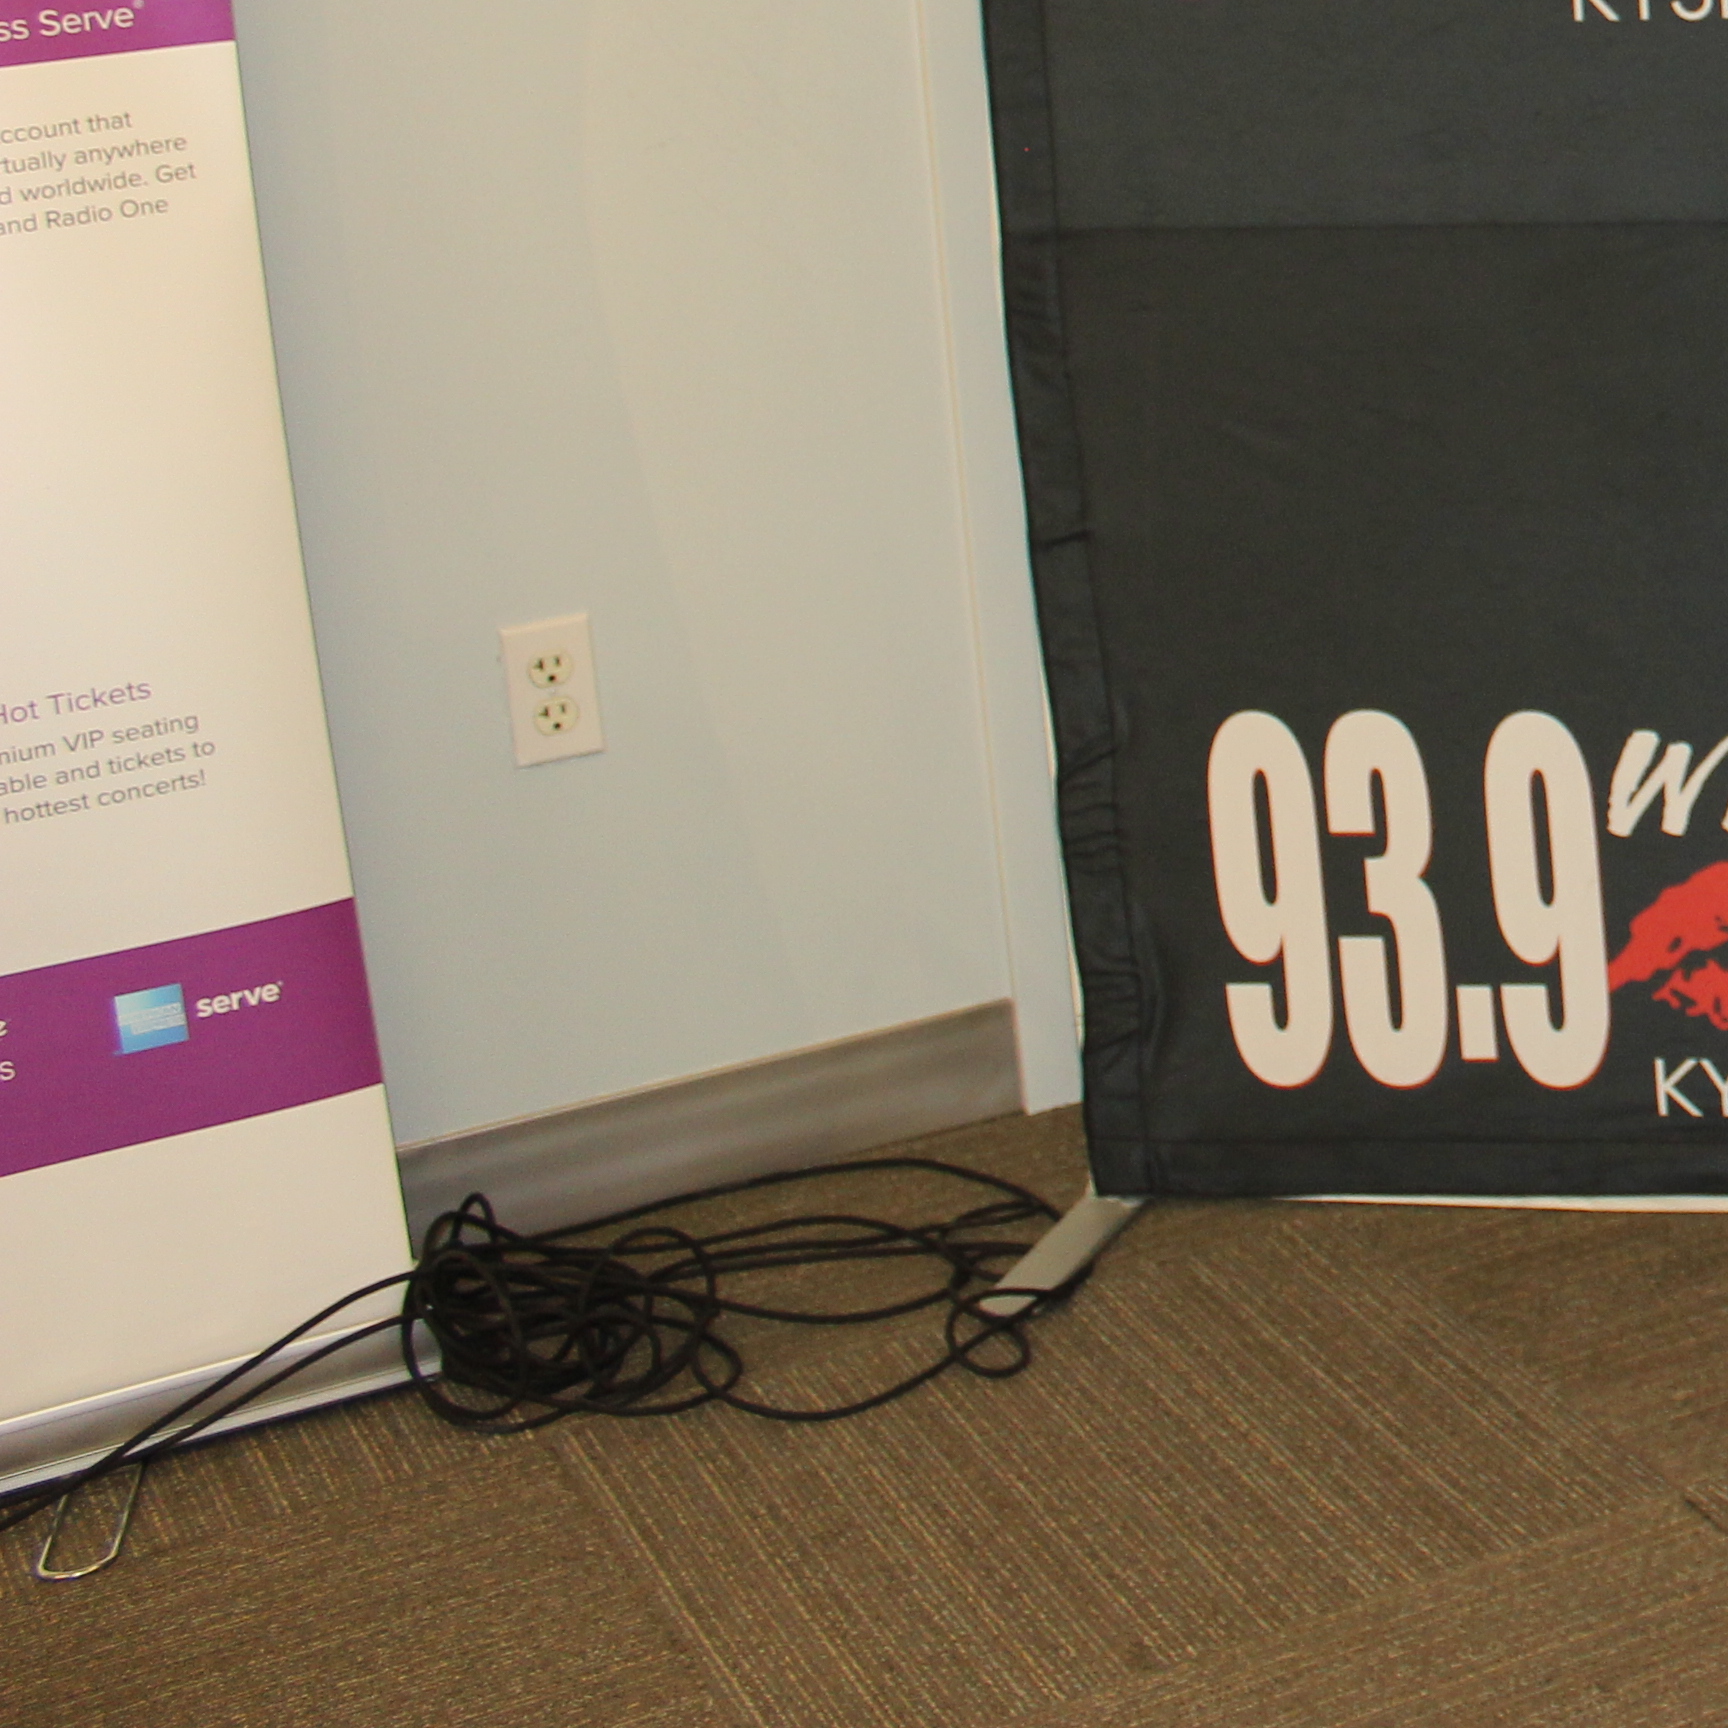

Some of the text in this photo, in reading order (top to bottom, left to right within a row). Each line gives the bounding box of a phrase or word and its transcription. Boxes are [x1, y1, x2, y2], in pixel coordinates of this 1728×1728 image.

[88, 112, 132, 133] that
[74, 137, 187, 167] anywhere
[20, 171, 148, 202] worldwide.
[155, 163, 197, 184] Get
[46, 206, 113, 229] Radio
[120, 199, 169, 219] One
[46, 682, 152, 715] Tickets
[63, 729, 104, 752] VIP
[112, 715, 199, 744] seating
[55, 760, 101, 785] and
[108, 747, 186, 775] tickets
[193, 741, 216, 759] to
[4, 769, 206, 824] hottest concerts!
[1208, 709, 1610, 1088] 93.9
[196, 983, 281, 1018] serve
